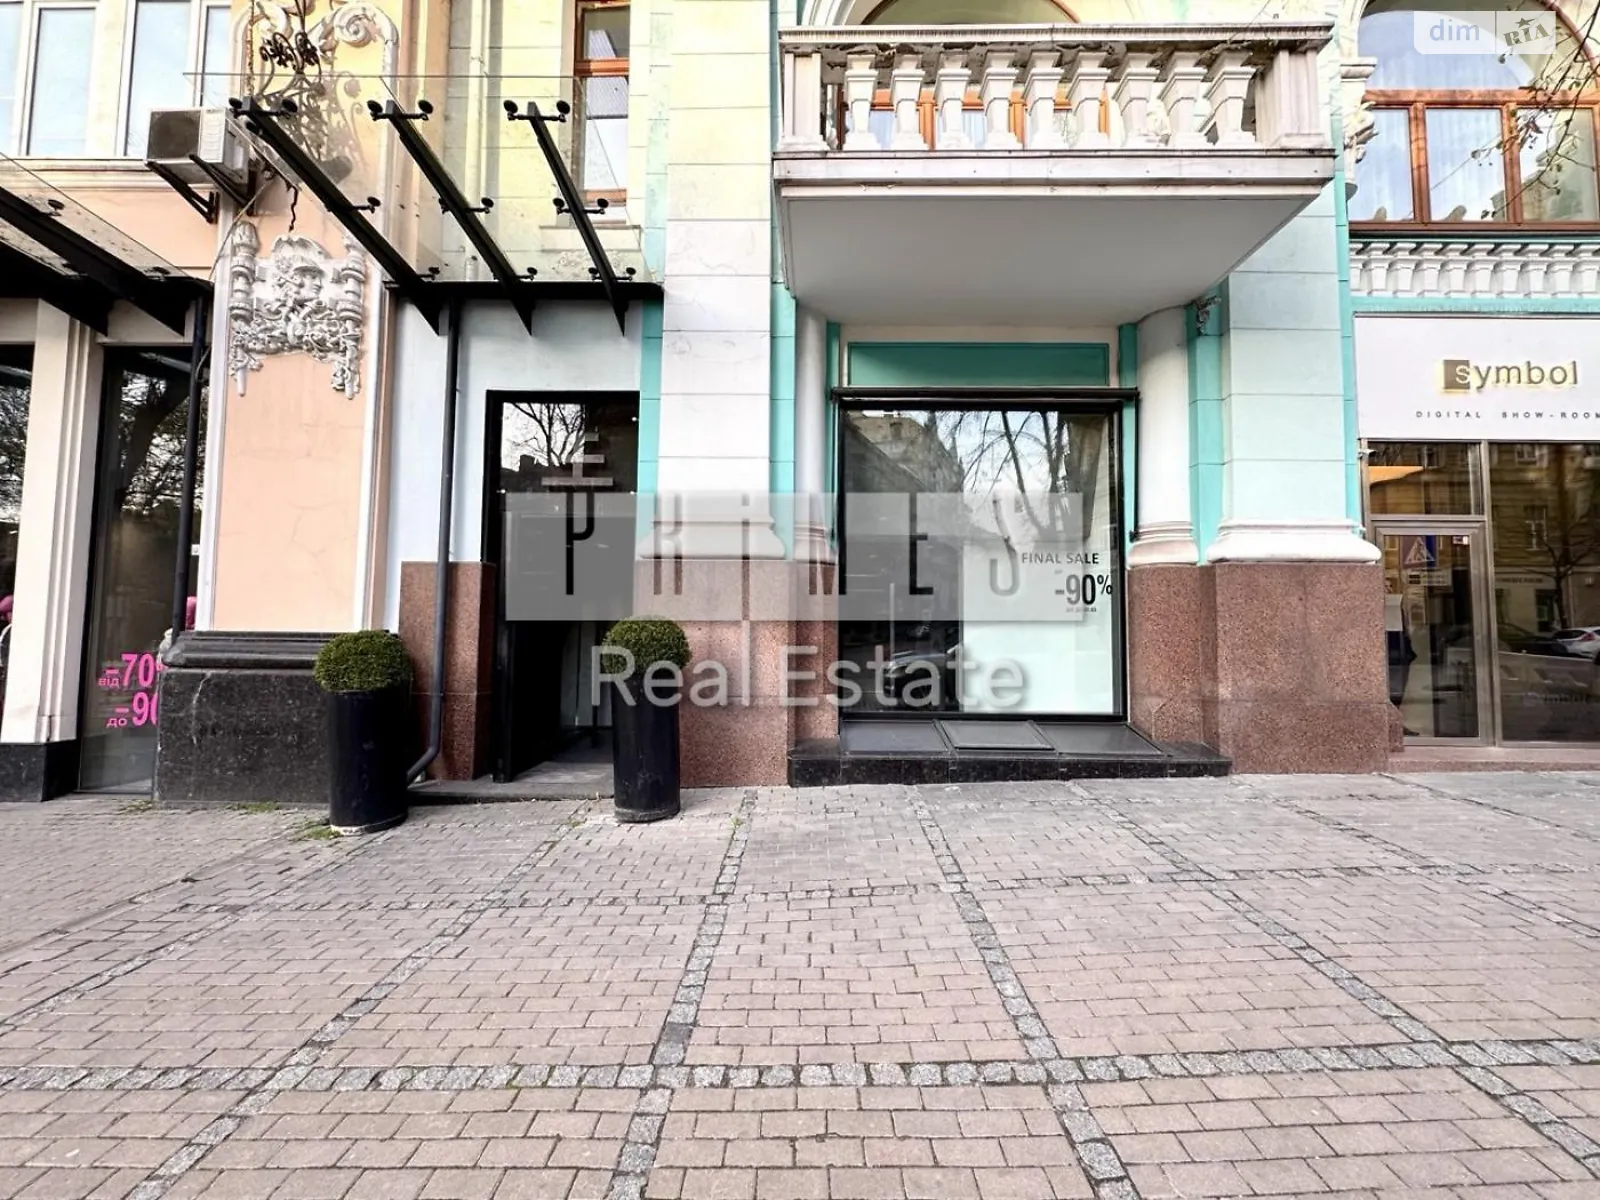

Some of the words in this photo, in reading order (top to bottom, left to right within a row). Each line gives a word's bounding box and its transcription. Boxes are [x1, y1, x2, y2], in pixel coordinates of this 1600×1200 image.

[1444, 359, 1578, 389] symbol
[1416, 411, 1481, 419] DIGITAL
[1022, 552, 1062, 564] FINAL
[1066, 552, 1100, 565] SALE
[1055, 573, 1113, 606] -90%
[98, 677, 120, 689] від
[106, 718, 128, 728] до
